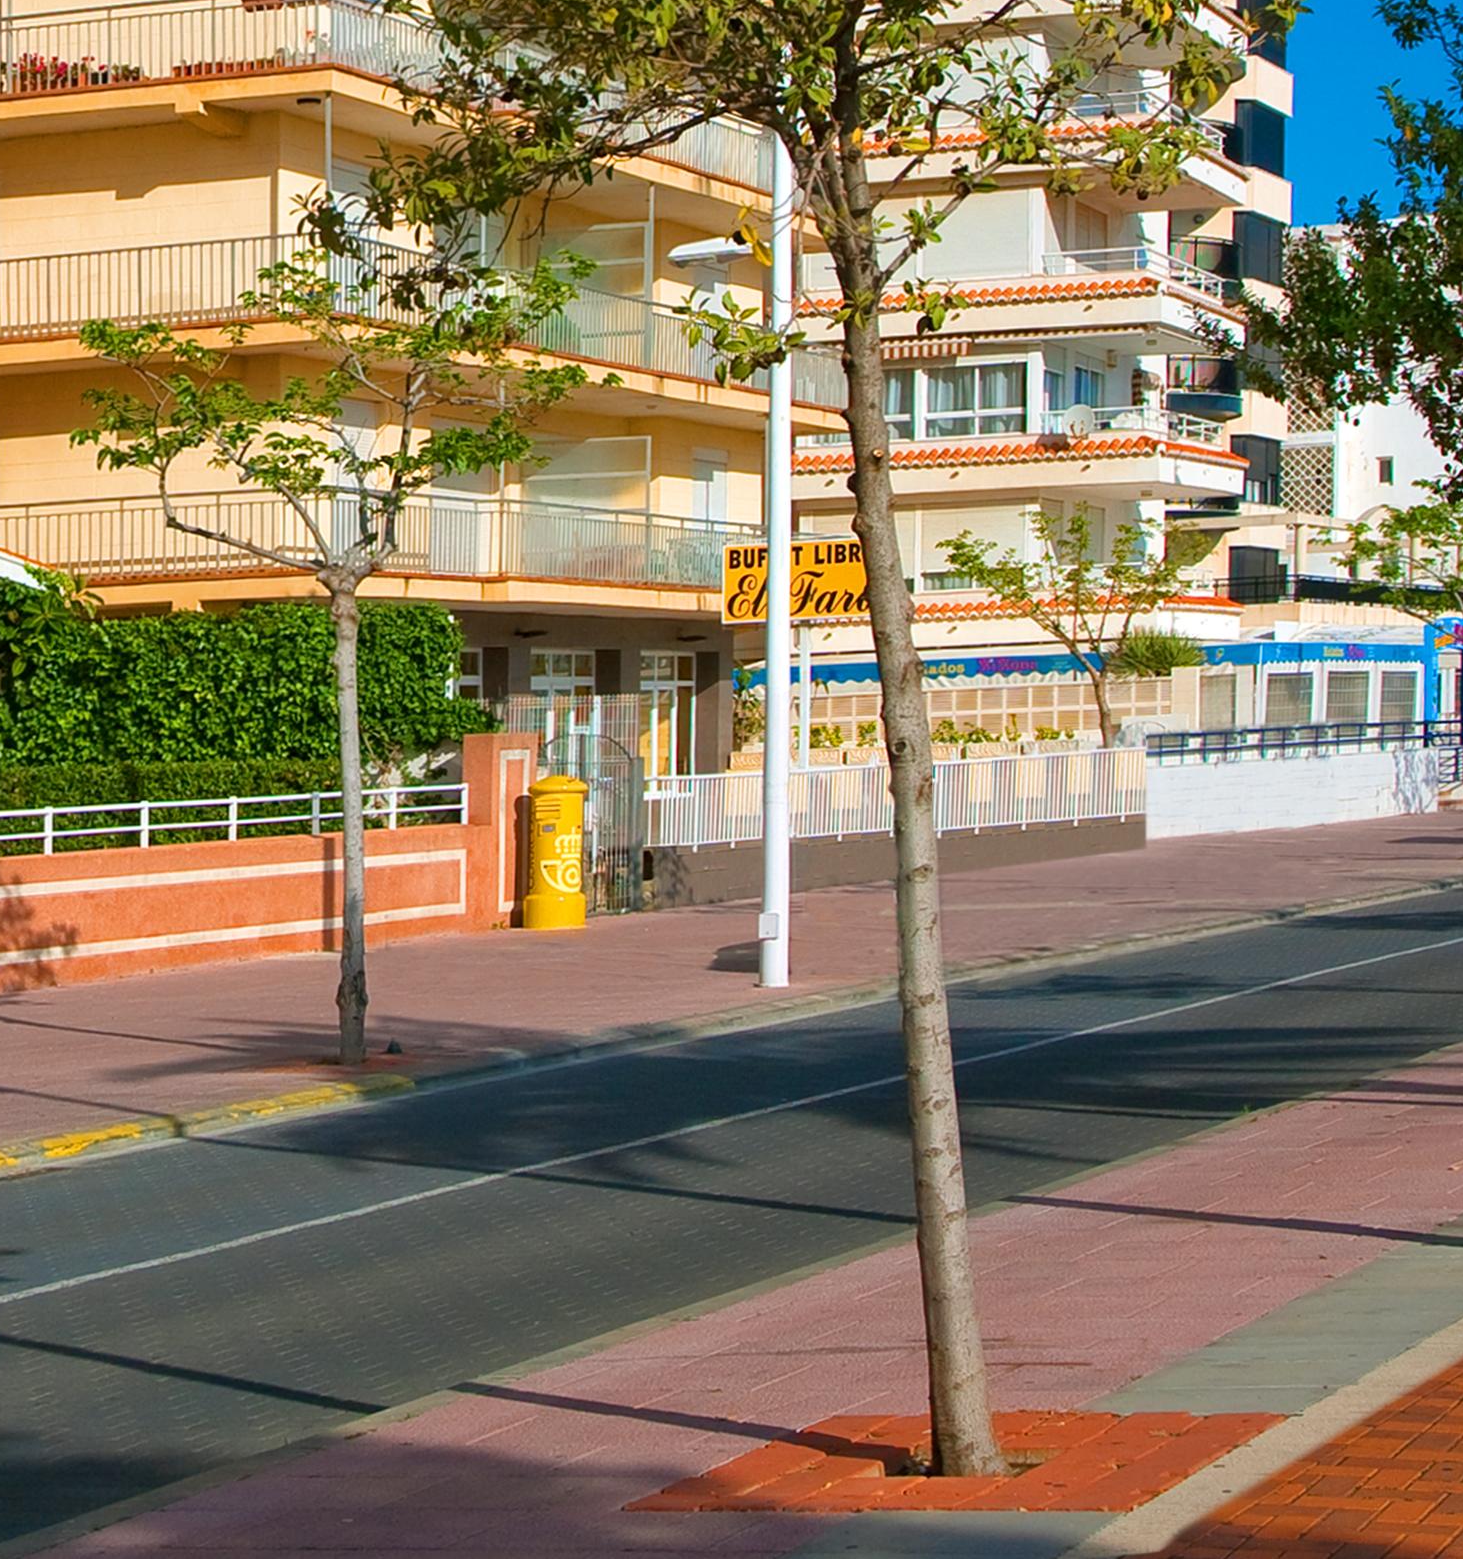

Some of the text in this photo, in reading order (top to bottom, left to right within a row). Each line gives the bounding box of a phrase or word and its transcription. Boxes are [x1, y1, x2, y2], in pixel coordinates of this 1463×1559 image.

[728, 543, 861, 570] BUFT LIBR
[726, 570, 871, 619] El Faro
